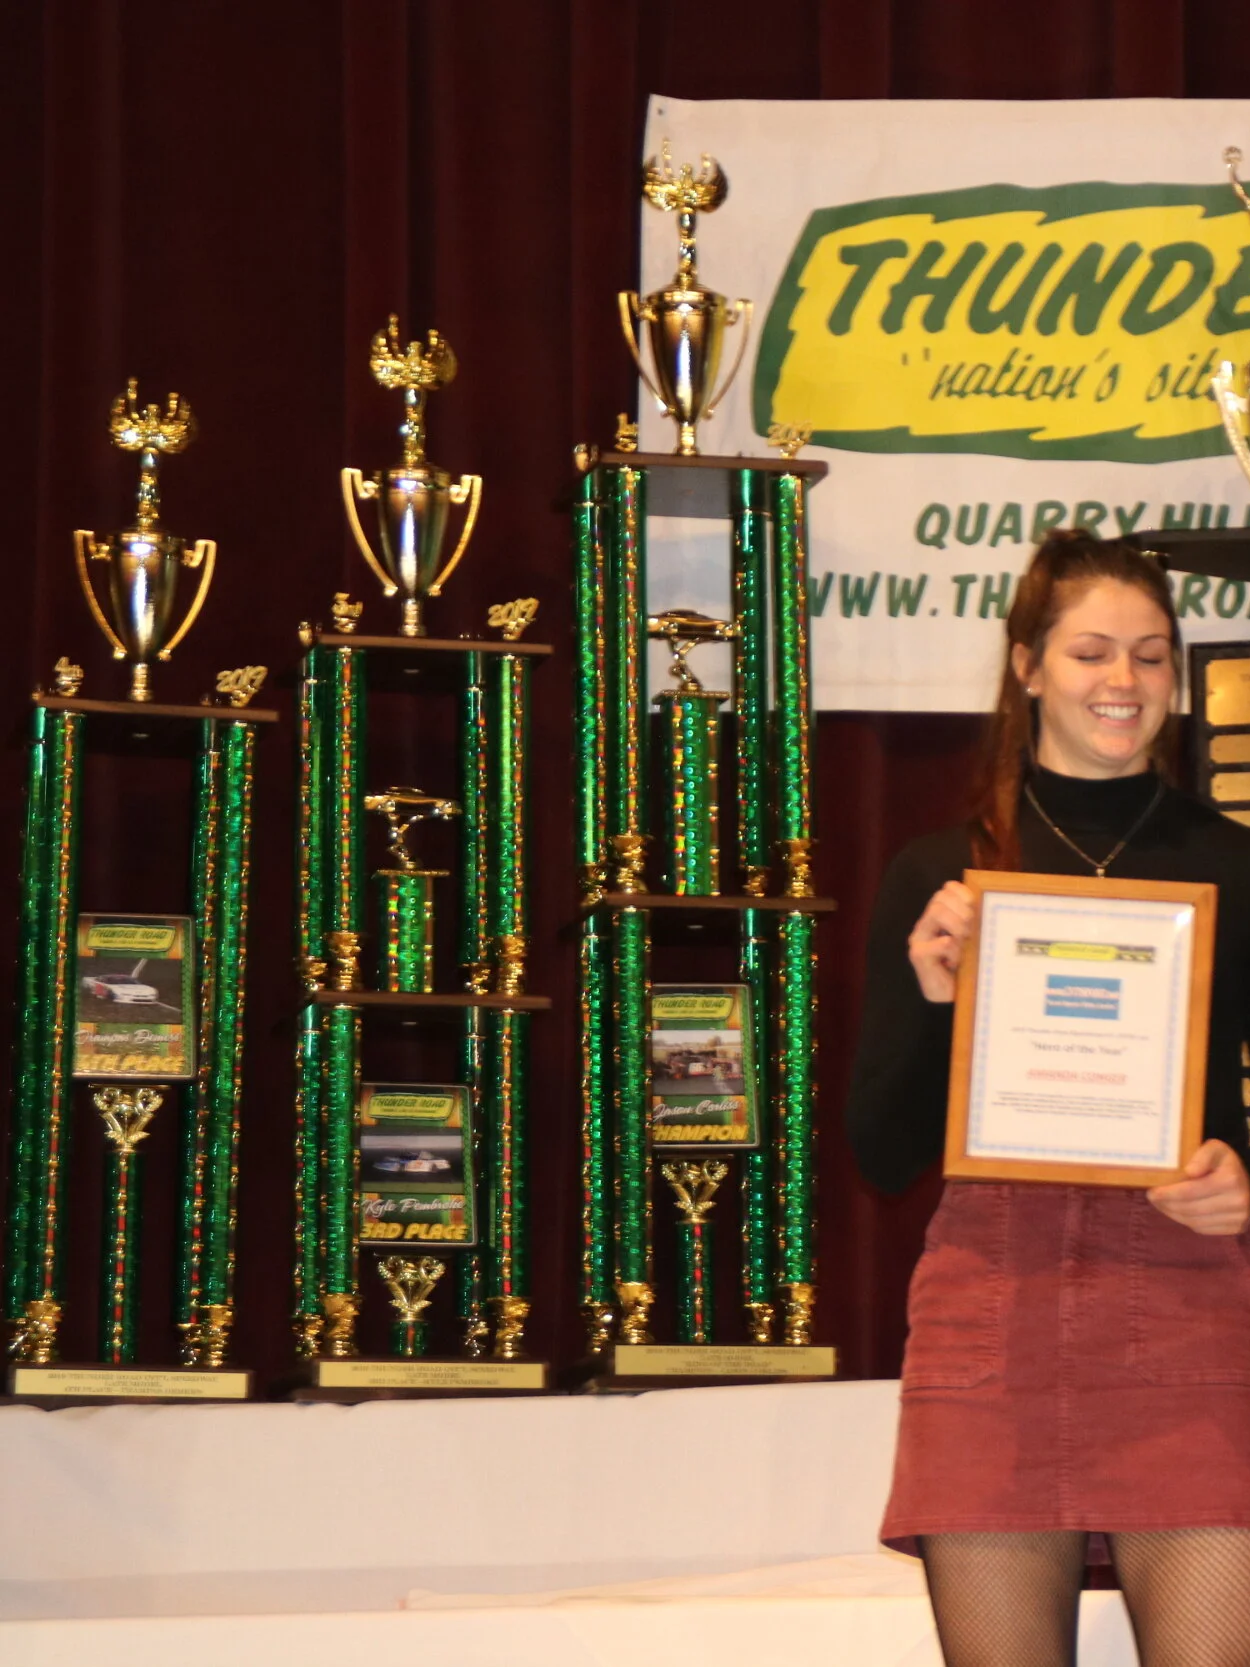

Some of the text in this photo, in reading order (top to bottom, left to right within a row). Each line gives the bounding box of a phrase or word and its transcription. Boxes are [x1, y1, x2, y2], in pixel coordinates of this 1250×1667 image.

[915, 500, 1146, 549] QUARRY
[653, 1124, 749, 1141] HAMPION
[360, 1222, 469, 1240] 3RD PLACE
